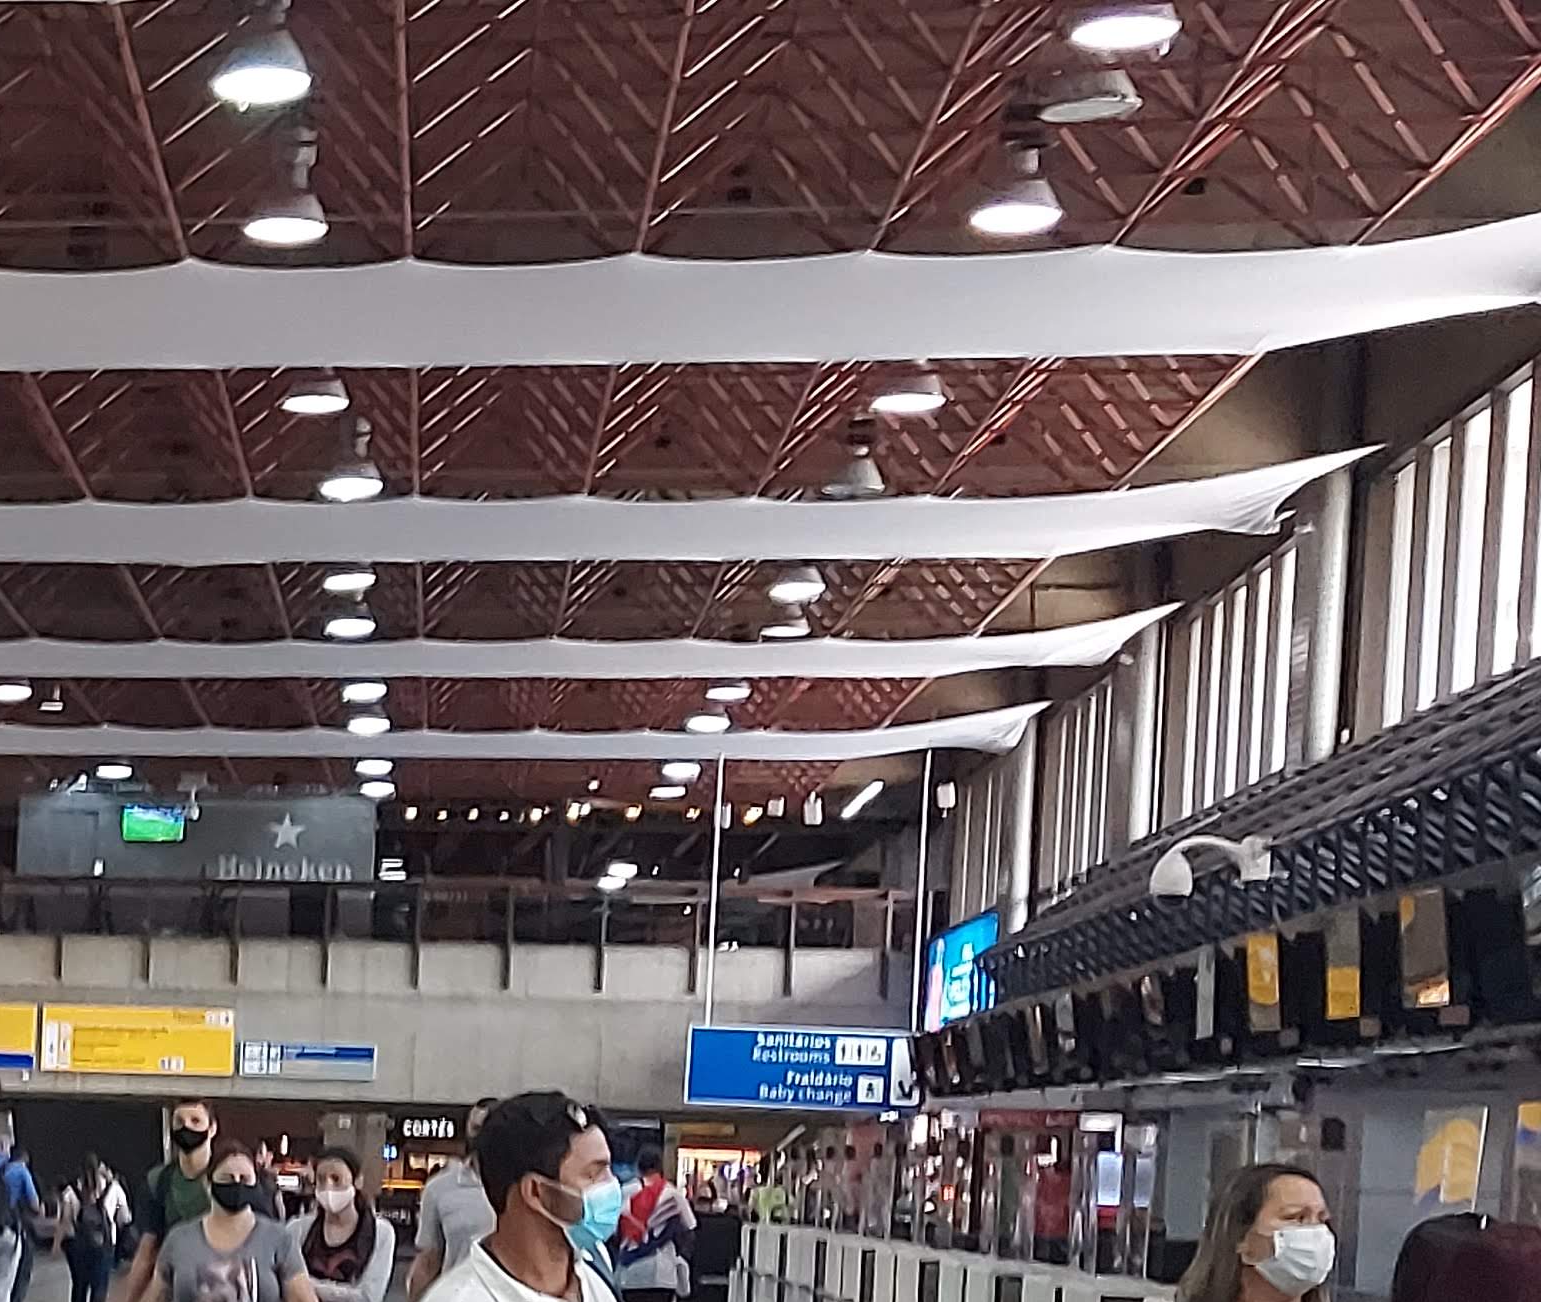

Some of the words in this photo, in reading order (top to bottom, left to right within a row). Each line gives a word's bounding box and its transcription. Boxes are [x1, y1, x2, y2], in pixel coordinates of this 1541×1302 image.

[218, 854, 352, 882] Heineken
[752, 1045, 831, 1064] Restrooms
[759, 1083, 794, 1103] Baby
